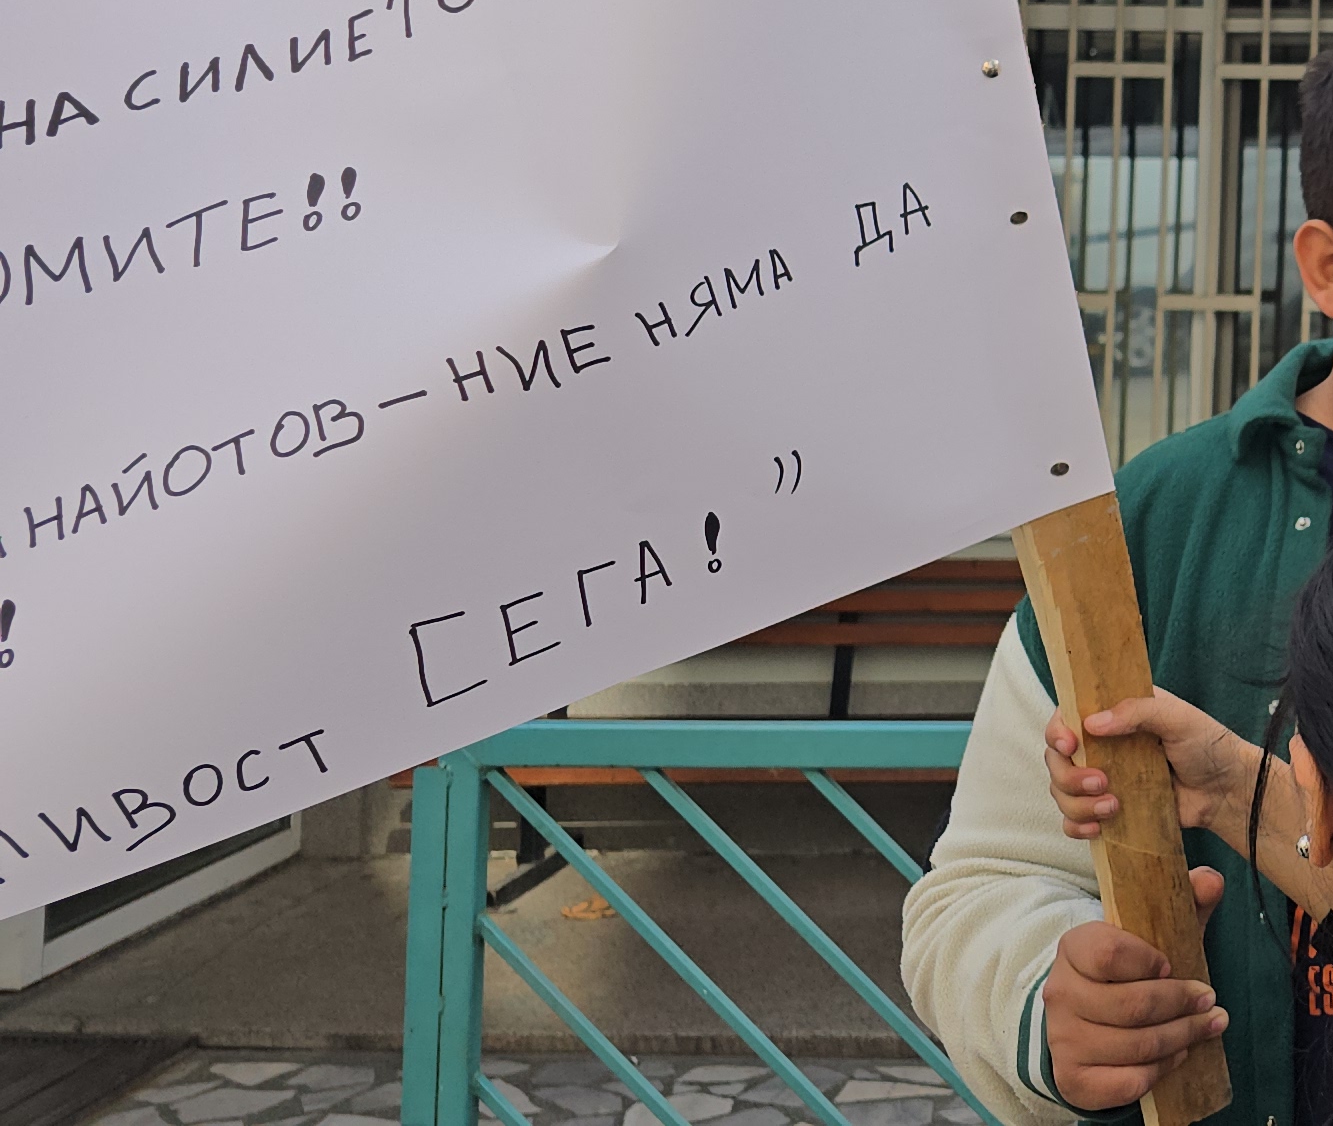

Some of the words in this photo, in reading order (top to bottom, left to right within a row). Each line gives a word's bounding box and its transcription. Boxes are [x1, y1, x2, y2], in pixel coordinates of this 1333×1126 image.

[0, 166, 362, 306] МИТЕ!!
[0, 396, 365, 558] НАЙОТОВ
[446, 323, 611, 402] НИЕ
[634, 247, 794, 347] НЯМА
[853, 182, 932, 267] ДА
